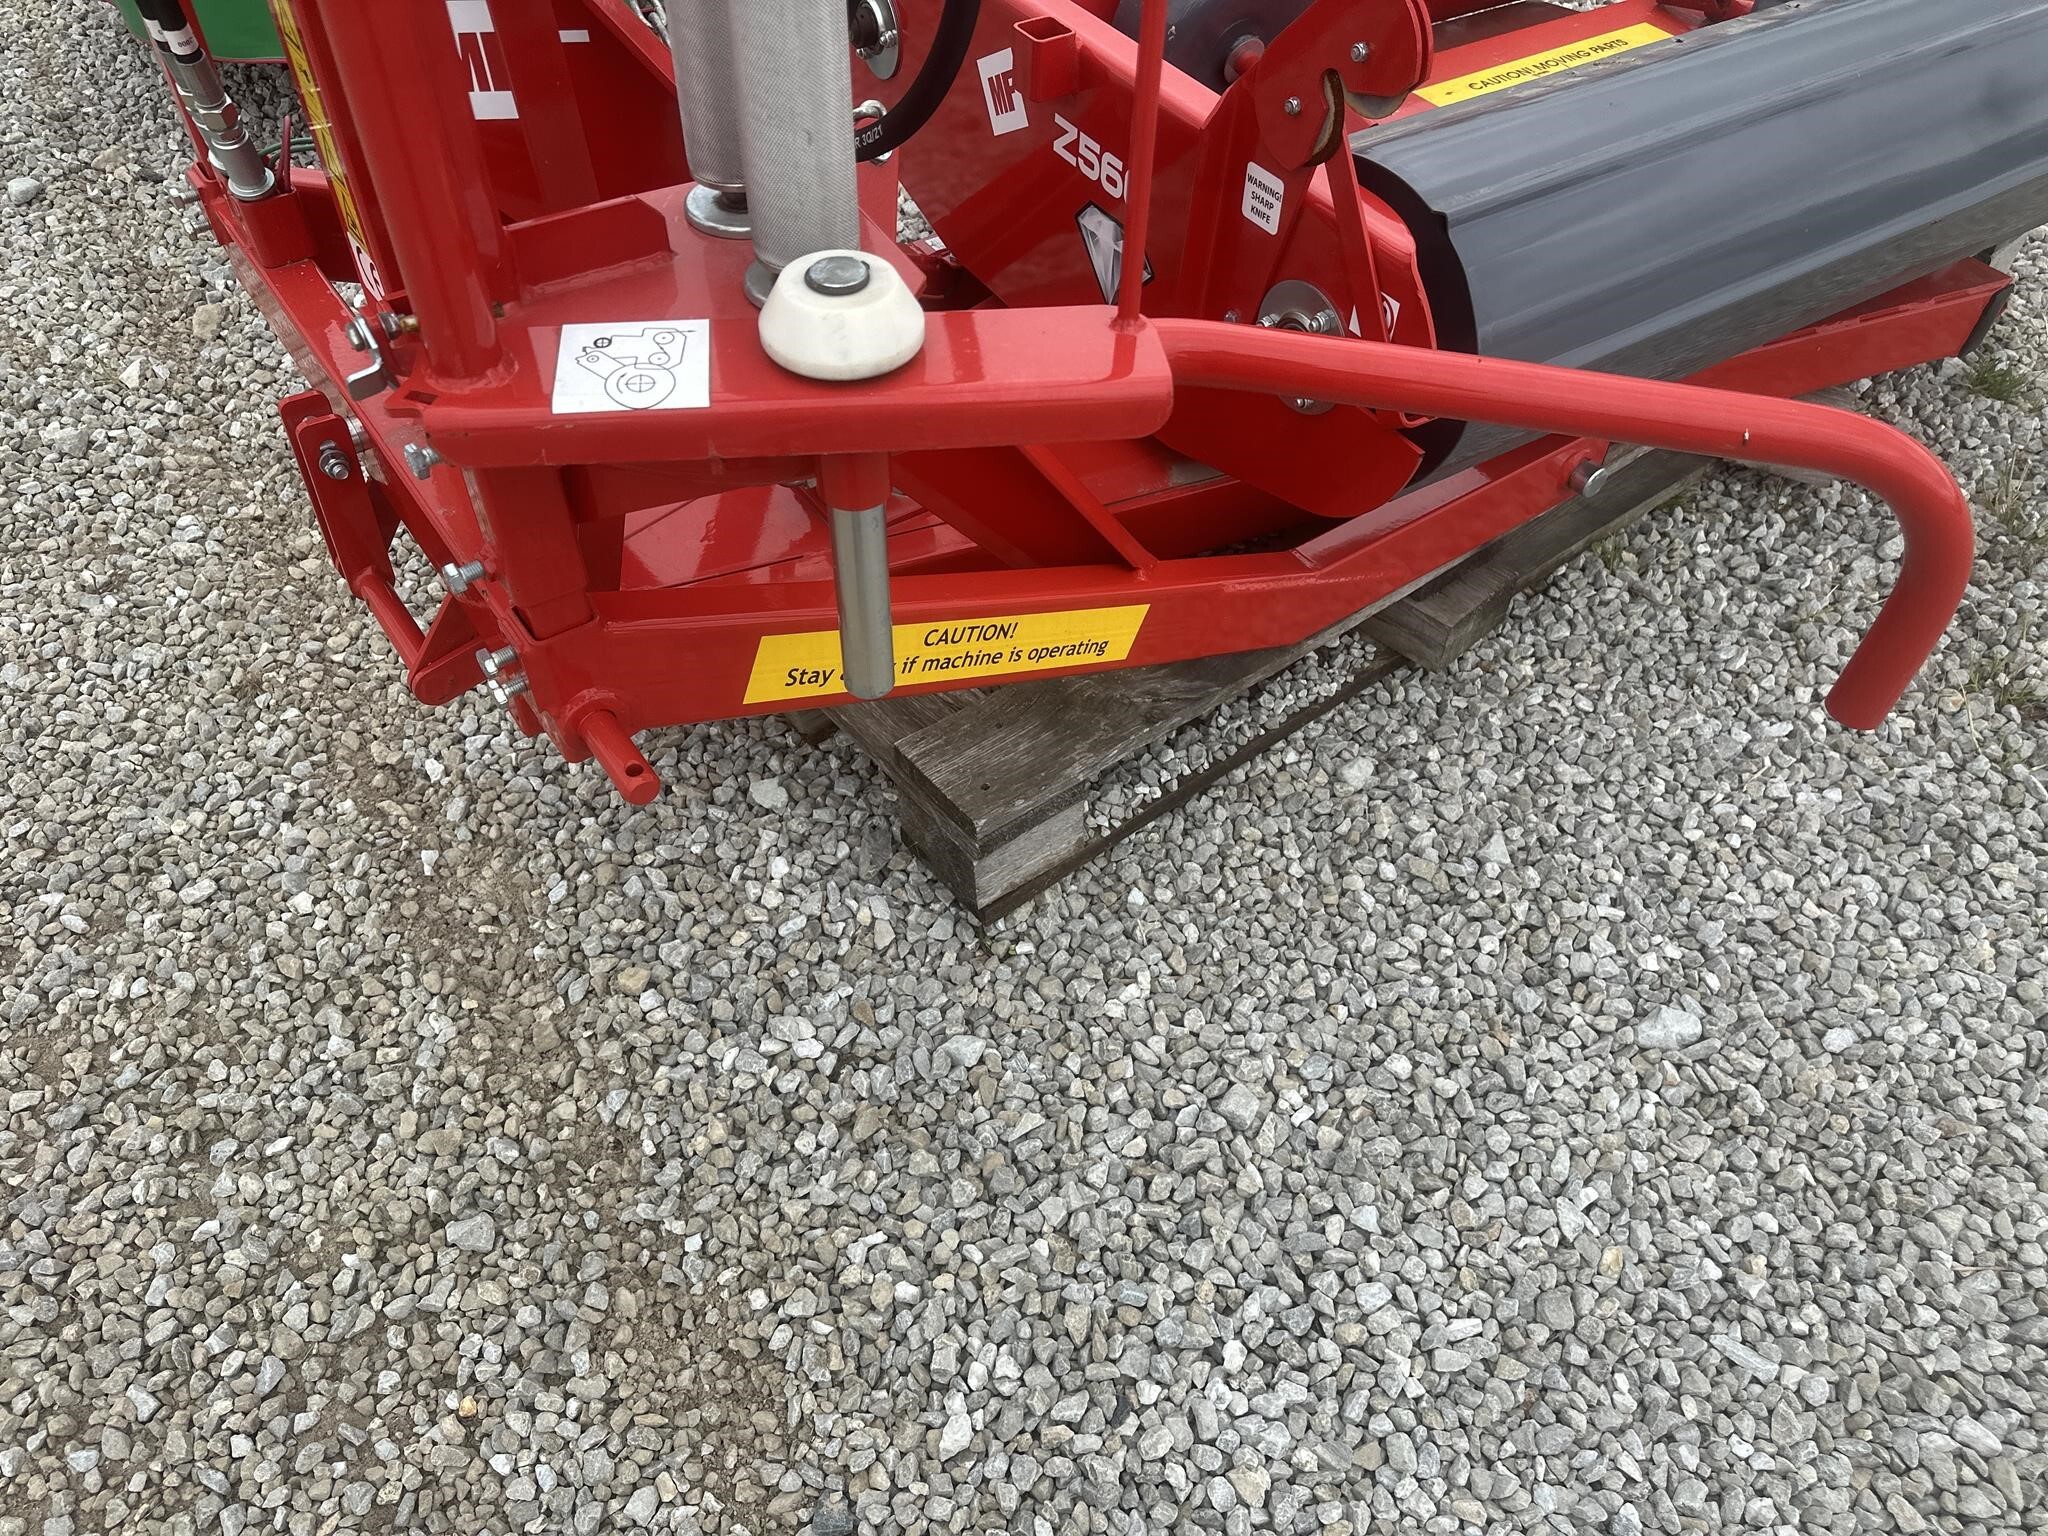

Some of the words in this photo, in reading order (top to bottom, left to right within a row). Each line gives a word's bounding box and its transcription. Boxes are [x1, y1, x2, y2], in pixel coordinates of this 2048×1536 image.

[1468, 66, 1535, 90] CAUTION!
[1532, 50, 1591, 71] MOVING
[1589, 39, 1629, 54] PARTS
[1053, 112, 1131, 204] Z56
[1247, 173, 1282, 203] WARNING!
[1250, 190, 1275, 211] SHARP
[1250, 204, 1271, 225] KNIFE
[923, 622, 1018, 647] CAUTION!
[785, 667, 835, 688] Stay
[901, 655, 920, 674] if
[921, 650, 1004, 673] machine
[1008, 646, 1024, 663] is
[1027, 639, 1110, 664] operating
